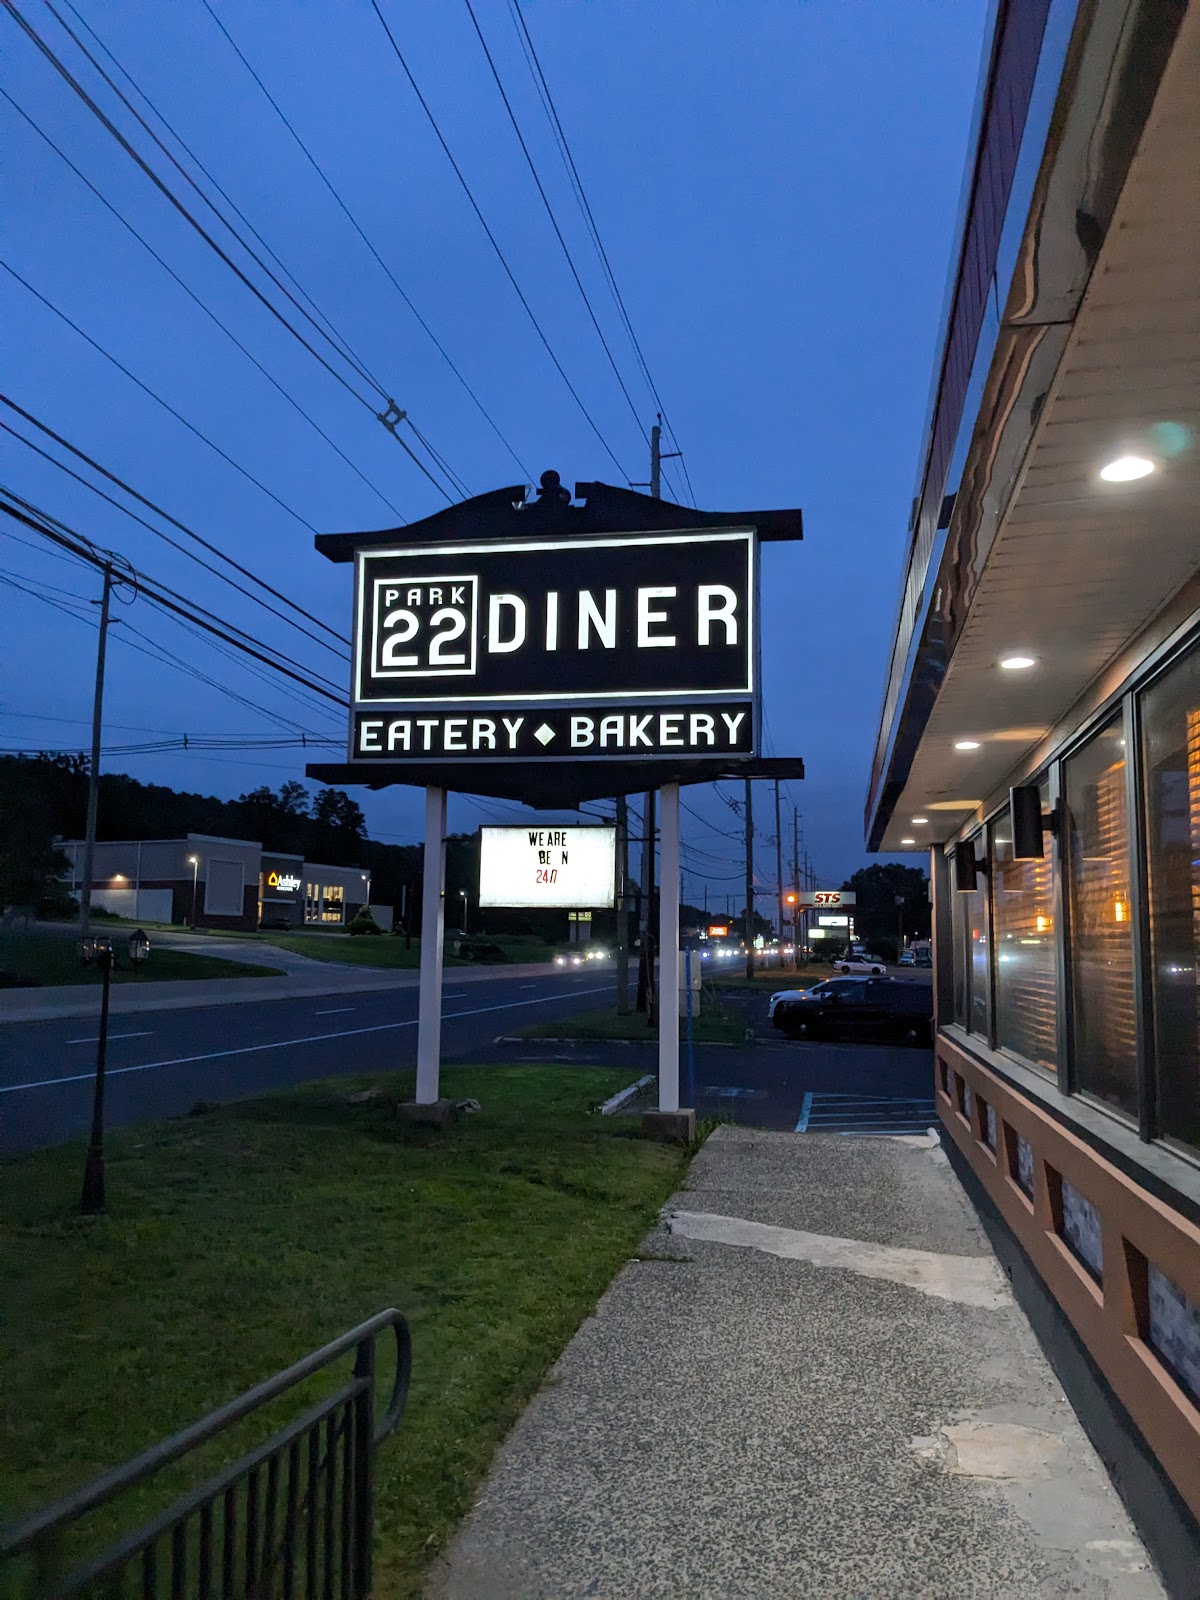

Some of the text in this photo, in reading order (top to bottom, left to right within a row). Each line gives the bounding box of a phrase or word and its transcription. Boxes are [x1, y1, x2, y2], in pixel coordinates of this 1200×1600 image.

[385, 586, 465, 607] PARK
[487, 584, 738, 654] DINER
[381, 608, 467, 667] 22
[359, 712, 745, 752] EATERY BAKERY
[528, 831, 567, 846] WE ARE
[277, 874, 302, 890] Ashley
[536, 869, 558, 883] 24/7
[814, 893, 840, 904] STS
